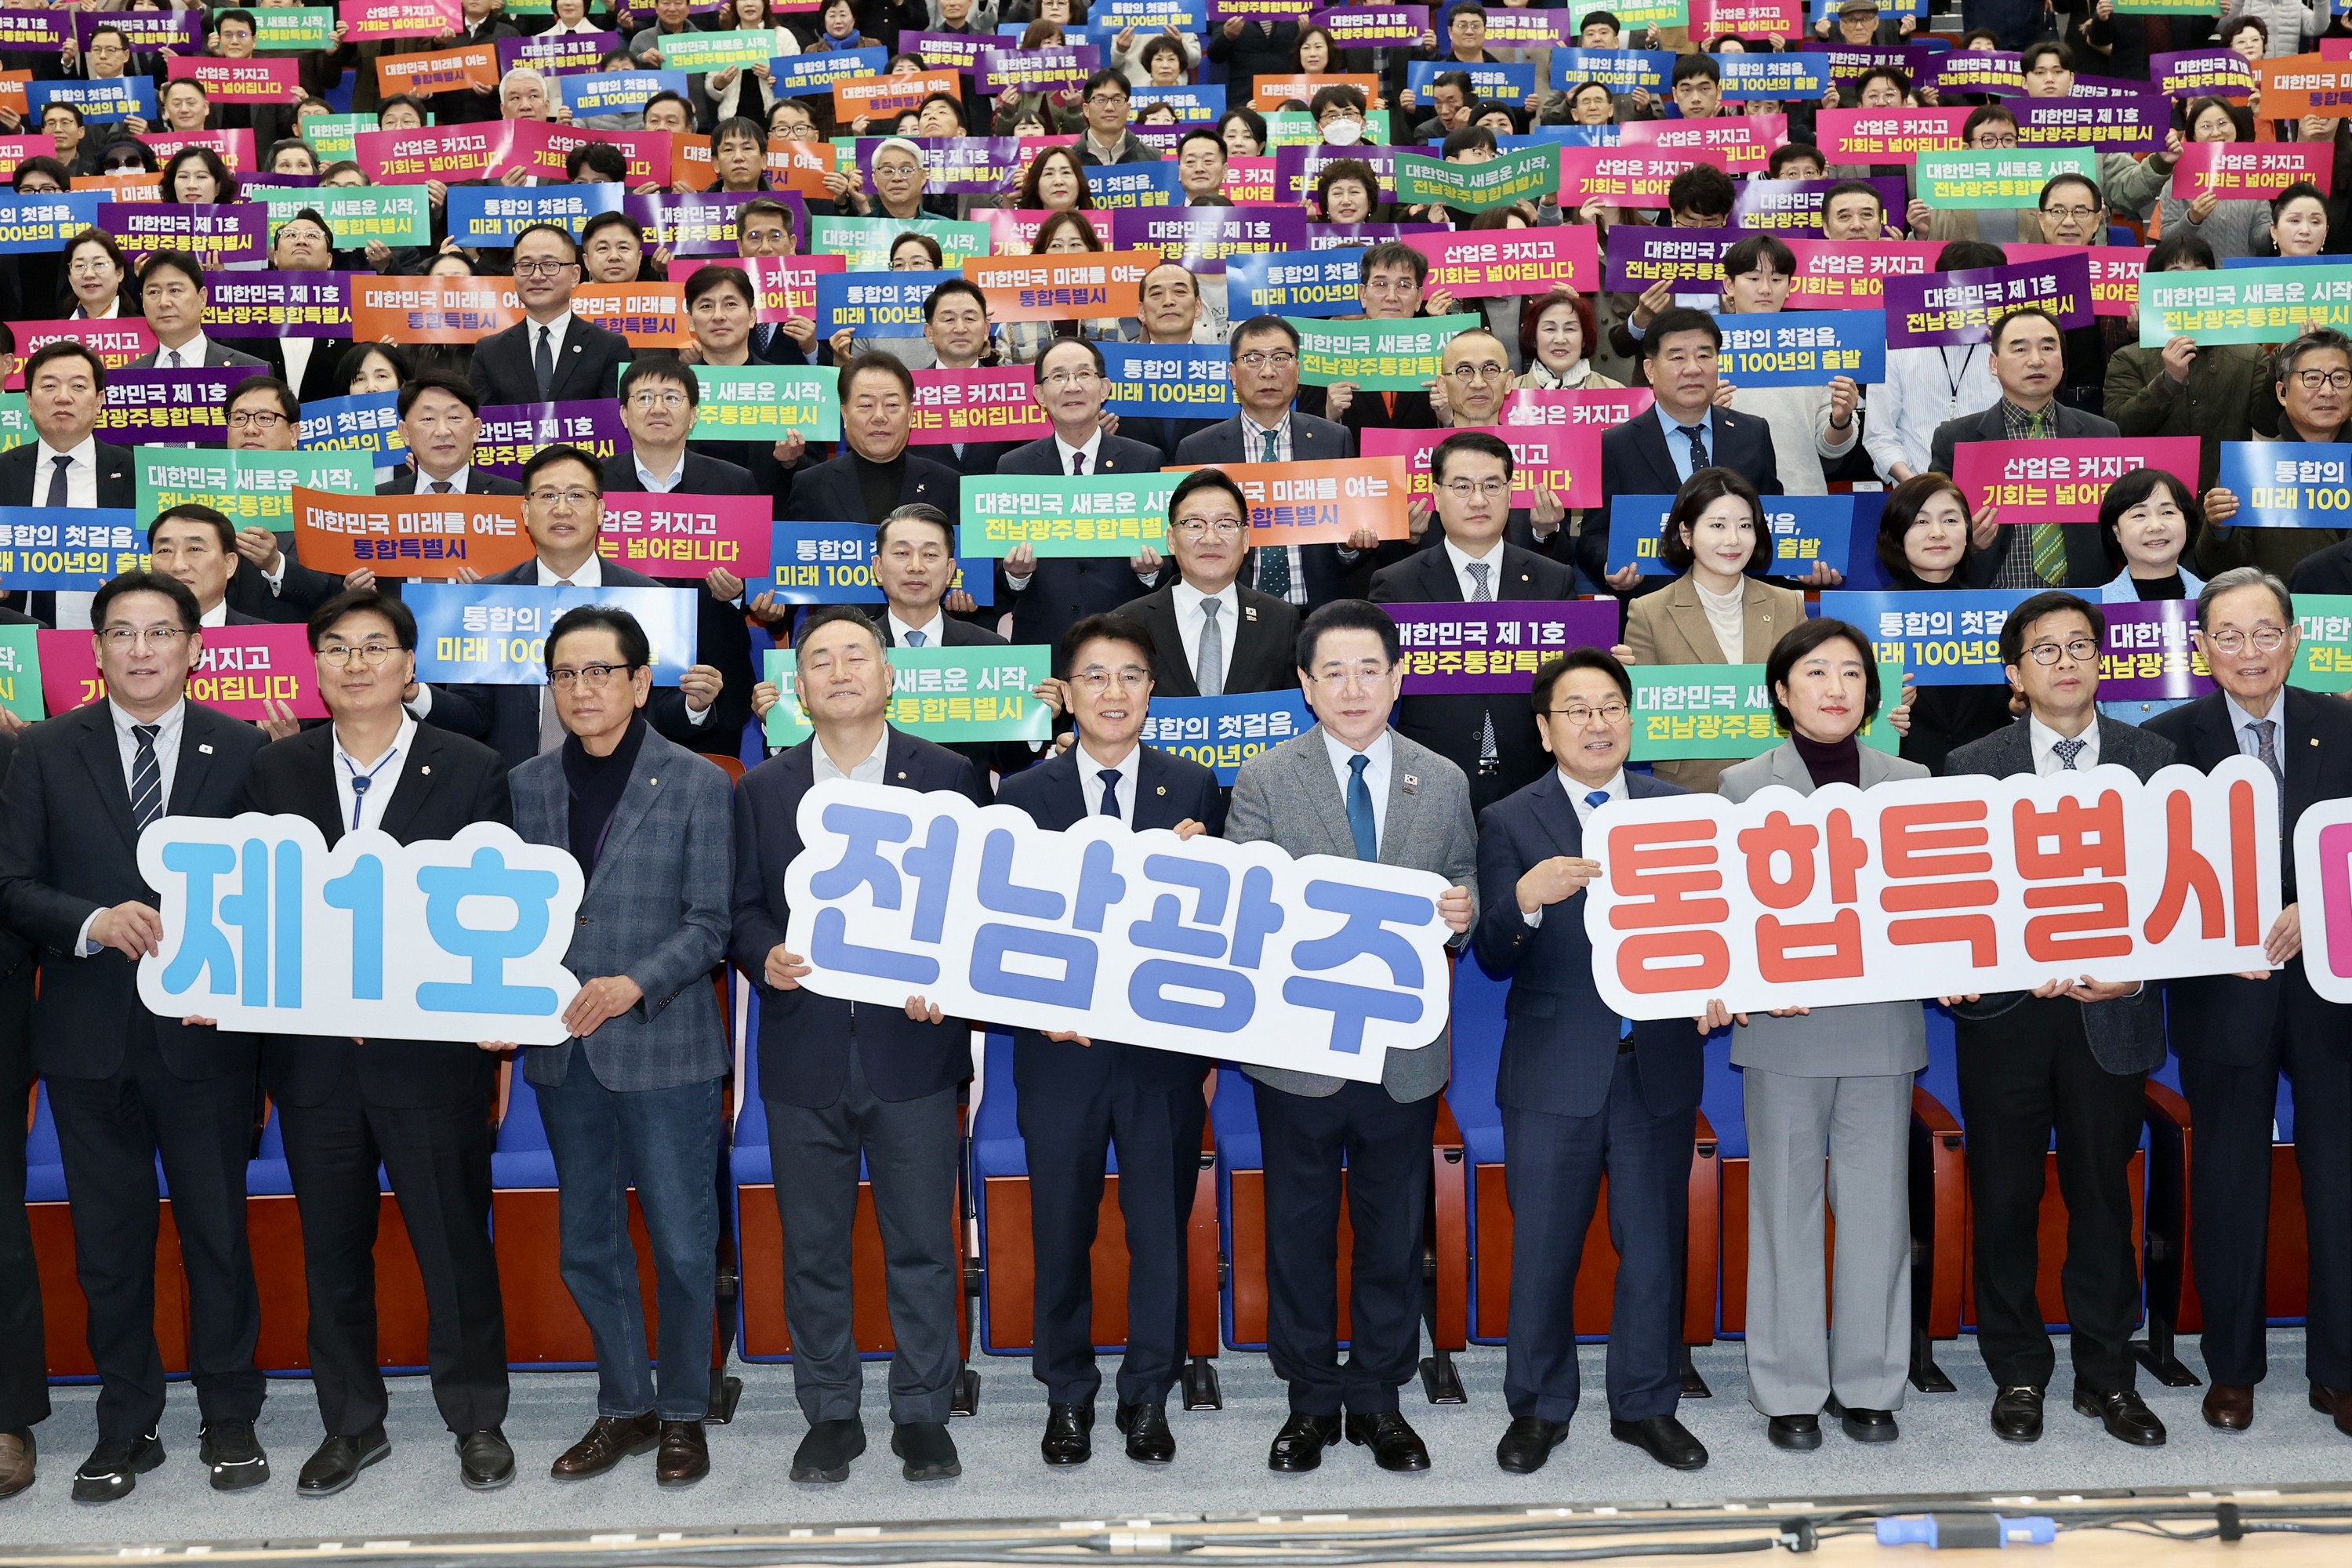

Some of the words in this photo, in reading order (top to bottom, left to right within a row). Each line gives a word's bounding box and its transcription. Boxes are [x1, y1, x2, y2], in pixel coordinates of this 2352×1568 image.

[1575, 0, 1617, 15] 대한민국
[1618, 0, 1653, 12] 새로운
[1714, 7, 1749, 20] 산업은
[1751, 7, 1780, 20] 커지고
[298, 15, 327, 30] 시작,
[356, 20, 390, 32] 기회는
[1102, 14, 1125, 27] 미래
[1125, 13, 1168, 27] 100년의
[1171, 13, 1193, 26] 출발
[1330, 13, 1374, 28] 대한민국
[1702, 20, 1736, 33] 기회는
[793, 61, 826, 75] 통합의
[828, 56, 866, 72] 첫걸음,
[996, 56, 1042, 72] 대한민국
[1577, 56, 1613, 71] 통합의
[1613, 57, 1653, 73] 첫걸음,
[1726, 63, 1764, 77] 통합의
[1947, 59, 1993, 73] 대한민국
[2173, 57, 2227, 75] 대한민국
[194, 67, 230, 79] 산업은
[231, 67, 270, 81] 커지고
[784, 74, 808, 88] 미래
[986, 68, 1089, 85] 전남광주통합특별시
[1565, 70, 1589, 85] 미래
[1591, 70, 1636, 85] 100년의
[1638, 71, 1661, 86] 출발
[1793, 75, 1819, 90] 출발
[2274, 74, 2336, 90] 대한민국
[0, 81, 24, 93] 여는
[87, 86, 128, 101] 첫걸음,
[586, 80, 621, 94] 통합의
[622, 78, 663, 93] 첫걸음,
[842, 85, 888, 101] 대한민국
[891, 81, 926, 96] 미래를
[927, 77, 951, 93] 여는
[1495, 84, 1521, 99] 출발
[116, 101, 141, 113] 출발
[1188, 106, 1212, 121] 출발
[2031, 108, 2093, 125] 대한민국
[1853, 120, 1899, 136] 산업은
[1902, 119, 1948, 136] 커지고
[392, 139, 438, 157] 산업은
[442, 134, 487, 153] 커지고
[1656, 130, 1701, 149] 산업은
[1704, 128, 1751, 146] 커지고
[1838, 137, 1882, 154] 기회는
[1887, 136, 1963, 154] 넓어집니다
[379, 159, 426, 176] 기회는
[429, 149, 504, 172] 넓어집니다
[1405, 163, 1465, 188] 대한민국
[1468, 165, 1513, 188] 새로운
[1517, 155, 1552, 176] 시작,
[1595, 159, 1644, 177] 산업은
[1926, 162, 1991, 180] 대한민국
[1994, 161, 2043, 178] 새로운
[2210, 155, 2256, 172] 산업은
[2261, 154, 2305, 171] 커지고
[1106, 174, 1155, 191] 첫걸음,
[1413, 171, 1544, 205] 전남광주통합특별시
[1579, 177, 1627, 196] 기회는
[2194, 172, 2241, 188] 기회는
[331, 200, 378, 216] 새로운
[382, 198, 419, 216] 시작,
[484, 199, 529, 216] 통합의
[537, 196, 589, 215] 첫걸음,
[1140, 191, 1171, 207] 출발
[1759, 192, 1824, 211] 대한민국
[20, 205, 75, 222] 첫걸음,
[658, 207, 721, 223] 대한민국
[128, 216, 191, 233] 대한민국
[469, 218, 503, 234] 미래
[1148, 220, 1218, 239] 대한민국
[114, 233, 252, 250] 전남광주통합특별시
[942, 234, 979, 250] 시작,
[1643, 241, 1715, 260] 대한민국
[1443, 243, 1498, 264] 산업은
[1501, 241, 1555, 261] 커지고
[1428, 264, 1481, 285] 기회는
[1486, 260, 1575, 284] 넓어집니다
[1808, 256, 1864, 274] 산업은
[1870, 255, 1925, 274] 커지고
[765, 269, 817, 289] 커지고
[977, 269, 1048, 289] 대한민국
[1053, 267, 1107, 286] 미래를
[1111, 264, 1146, 283] 여는
[1267, 265, 1319, 285] 통합의
[215, 285, 285, 303] 대한민국
[847, 285, 899, 303] 통합의
[1290, 285, 1359, 304] 100년의
[1789, 275, 1845, 296] 기회는
[1923, 279, 2004, 309] 대한민국
[2152, 285, 2237, 308] 대한민국
[2242, 282, 2305, 303] 새로운
[365, 290, 437, 309] 대한민국
[443, 290, 497, 309] 미래를
[626, 296, 677, 315] 미래를
[1019, 287, 1107, 308] 통합특별시
[1251, 289, 1287, 306] 미래
[407, 312, 498, 330] 통합특별시
[833, 307, 865, 325] 미래
[2161, 306, 2350, 331] 전남광주통합특별시
[85, 331, 140, 352] 커지고
[327, 339, 336, 348] P
[1299, 332, 1370, 354] 대한민국
[1376, 333, 1432, 354] 새로운
[1776, 327, 1842, 349] 첫걸음,
[1122, 358, 1183, 381] 통합의
[1740, 350, 1816, 372] 100년의
[1820, 349, 1862, 371] 출발
[719, 381, 776, 402] 새로운
[781, 381, 827, 403] 시작,
[967, 382, 1027, 404] 커지고
[1148, 383, 1230, 404] 100년의
[949, 405, 1047, 429] 넓어집니다
[1507, 405, 1566, 426] 산업은
[1572, 405, 1632, 425] 커지고
[2003, 456, 2071, 481] 산업은
[2274, 460, 2345, 485] 통합의
[147, 465, 228, 490] 대한민국
[236, 469, 299, 492] 새로운
[307, 468, 359, 491] 시작,
[1272, 477, 1338, 502] 미래를
[1345, 475, 1389, 499] 여는
[1982, 483, 2047, 506] 기회는
[975, 492, 1064, 515] 대한민국
[1069, 492, 1137, 514] 새로운
[2251, 487, 2299, 510] 미래
[306, 506, 390, 534] 대한민국
[397, 512, 466, 535] 미래를
[472, 512, 517, 536] 여는
[649, 512, 717, 535] 커지고
[64, 524, 140, 549] 첫걸음,
[352, 539, 467, 560] 통합특별시
[626, 538, 740, 563] 넓어집니다
[795, 539, 863, 561] 통합의
[1777, 537, 1821, 559] 출발
[20, 552, 109, 575] 100년의
[775, 566, 820, 587] 미래
[462, 605, 541, 633] 통합의
[1878, 612, 1953, 637] 통합의
[436, 637, 488, 662] 미래
[892, 666, 968, 693] 새로운
[975, 666, 1035, 693] 시작,
[1635, 684, 1738, 711] 대한민국
[1218, 710, 1300, 738] 첫걸음,
[1607, 779, 2260, 995] 통합특별시
[161, 837, 560, 1017] 제1호
[809, 802, 1435, 1056] 전남광주
